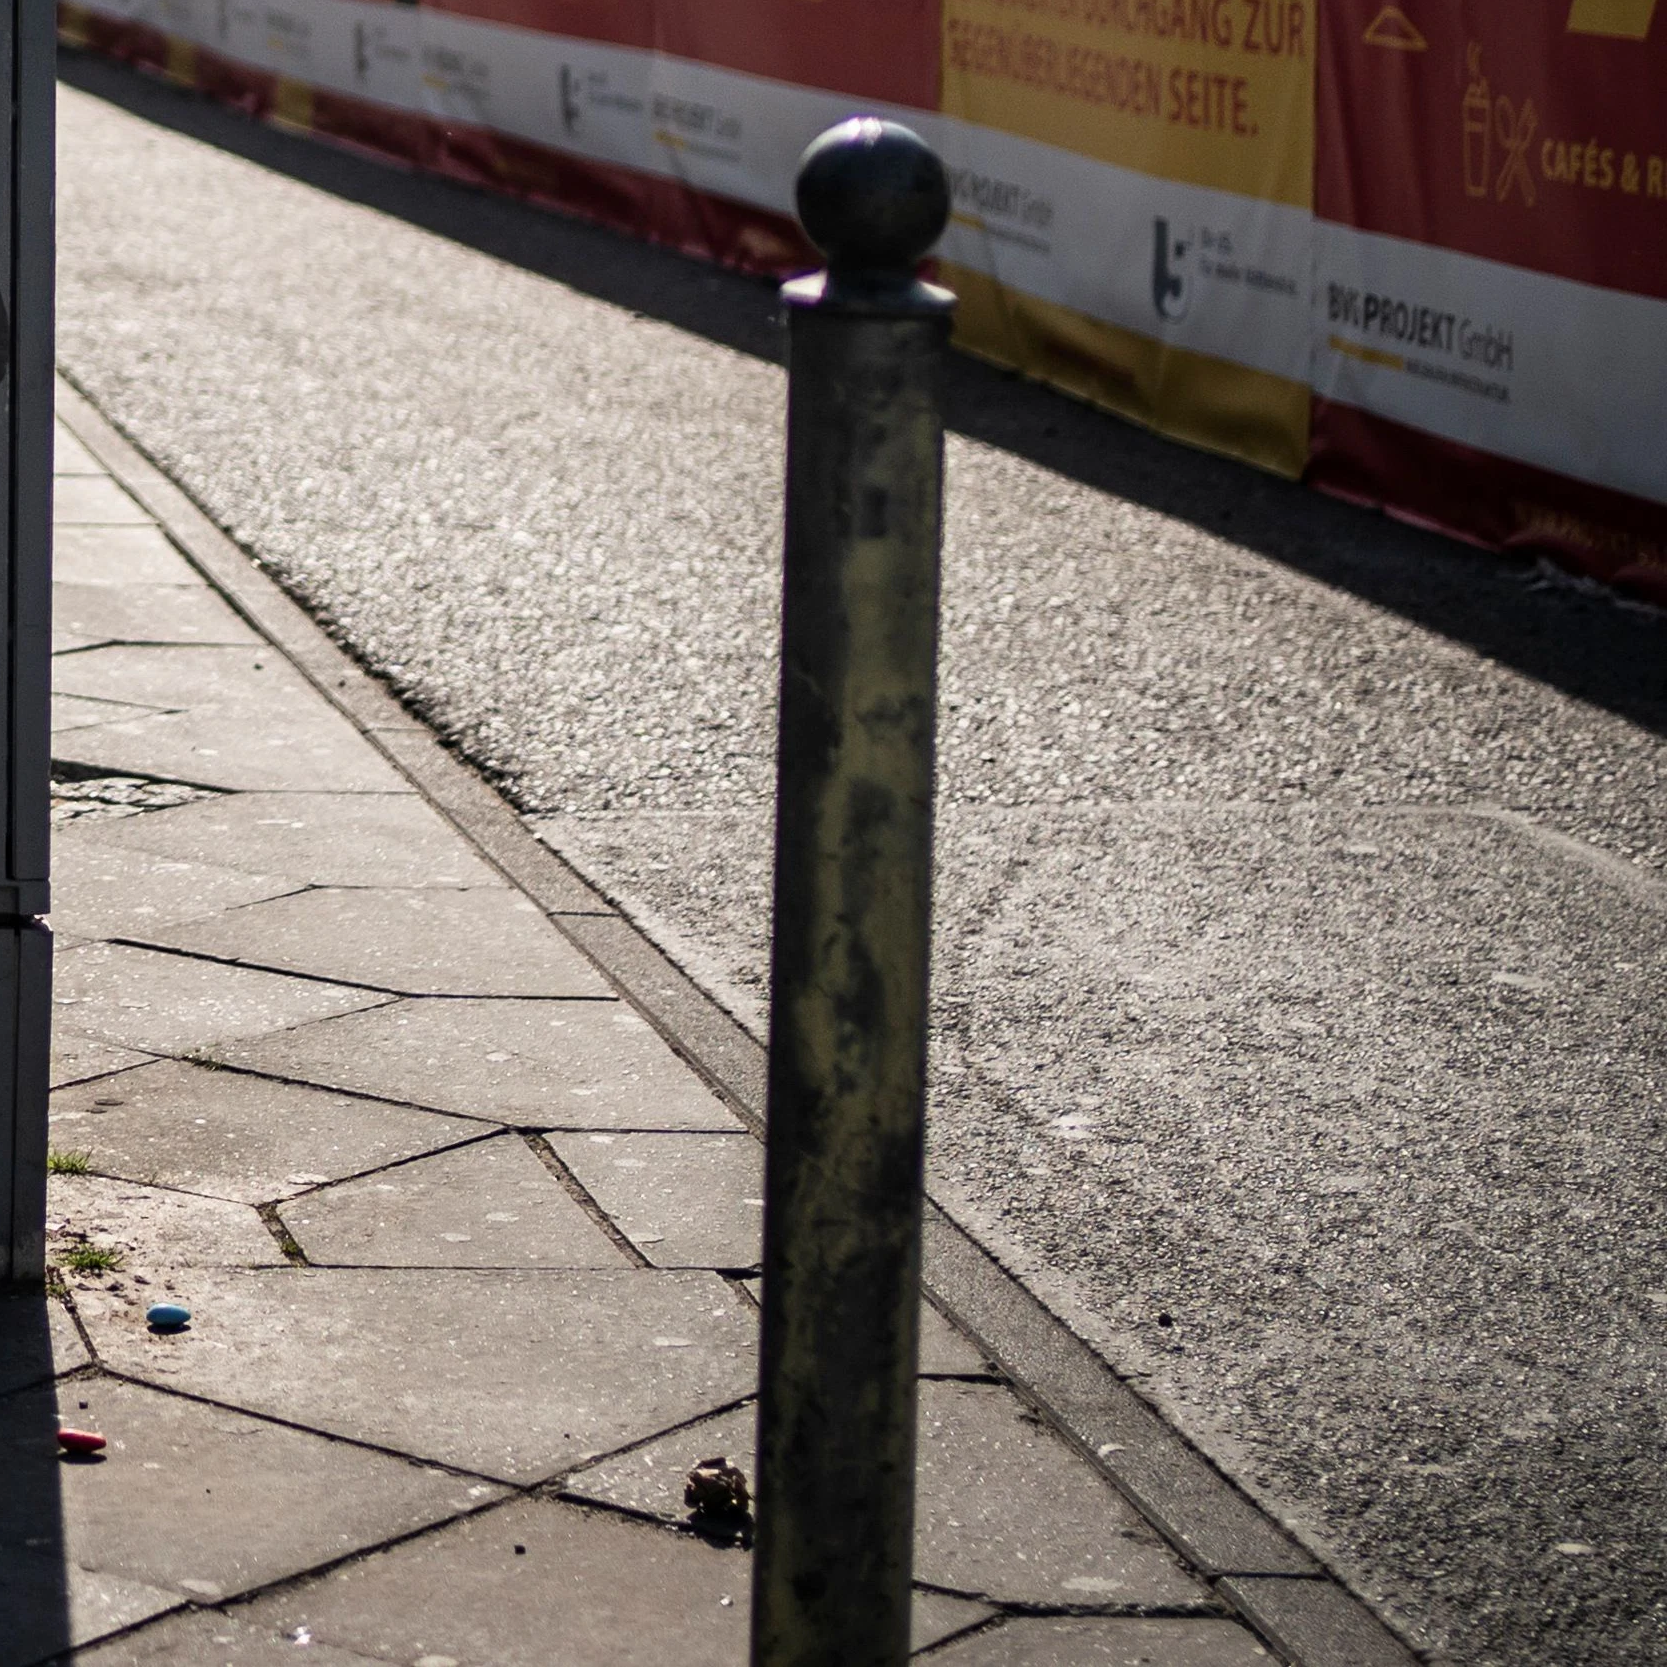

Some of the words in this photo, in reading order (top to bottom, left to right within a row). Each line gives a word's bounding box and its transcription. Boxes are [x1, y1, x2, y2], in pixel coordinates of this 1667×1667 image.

[1166, 65, 1260, 138] SEITE.
[1540, 137, 1615, 191] CAFÉS
[1621, 152, 1640, 196] &
[1362, 292, 1456, 353] PROJEKT
